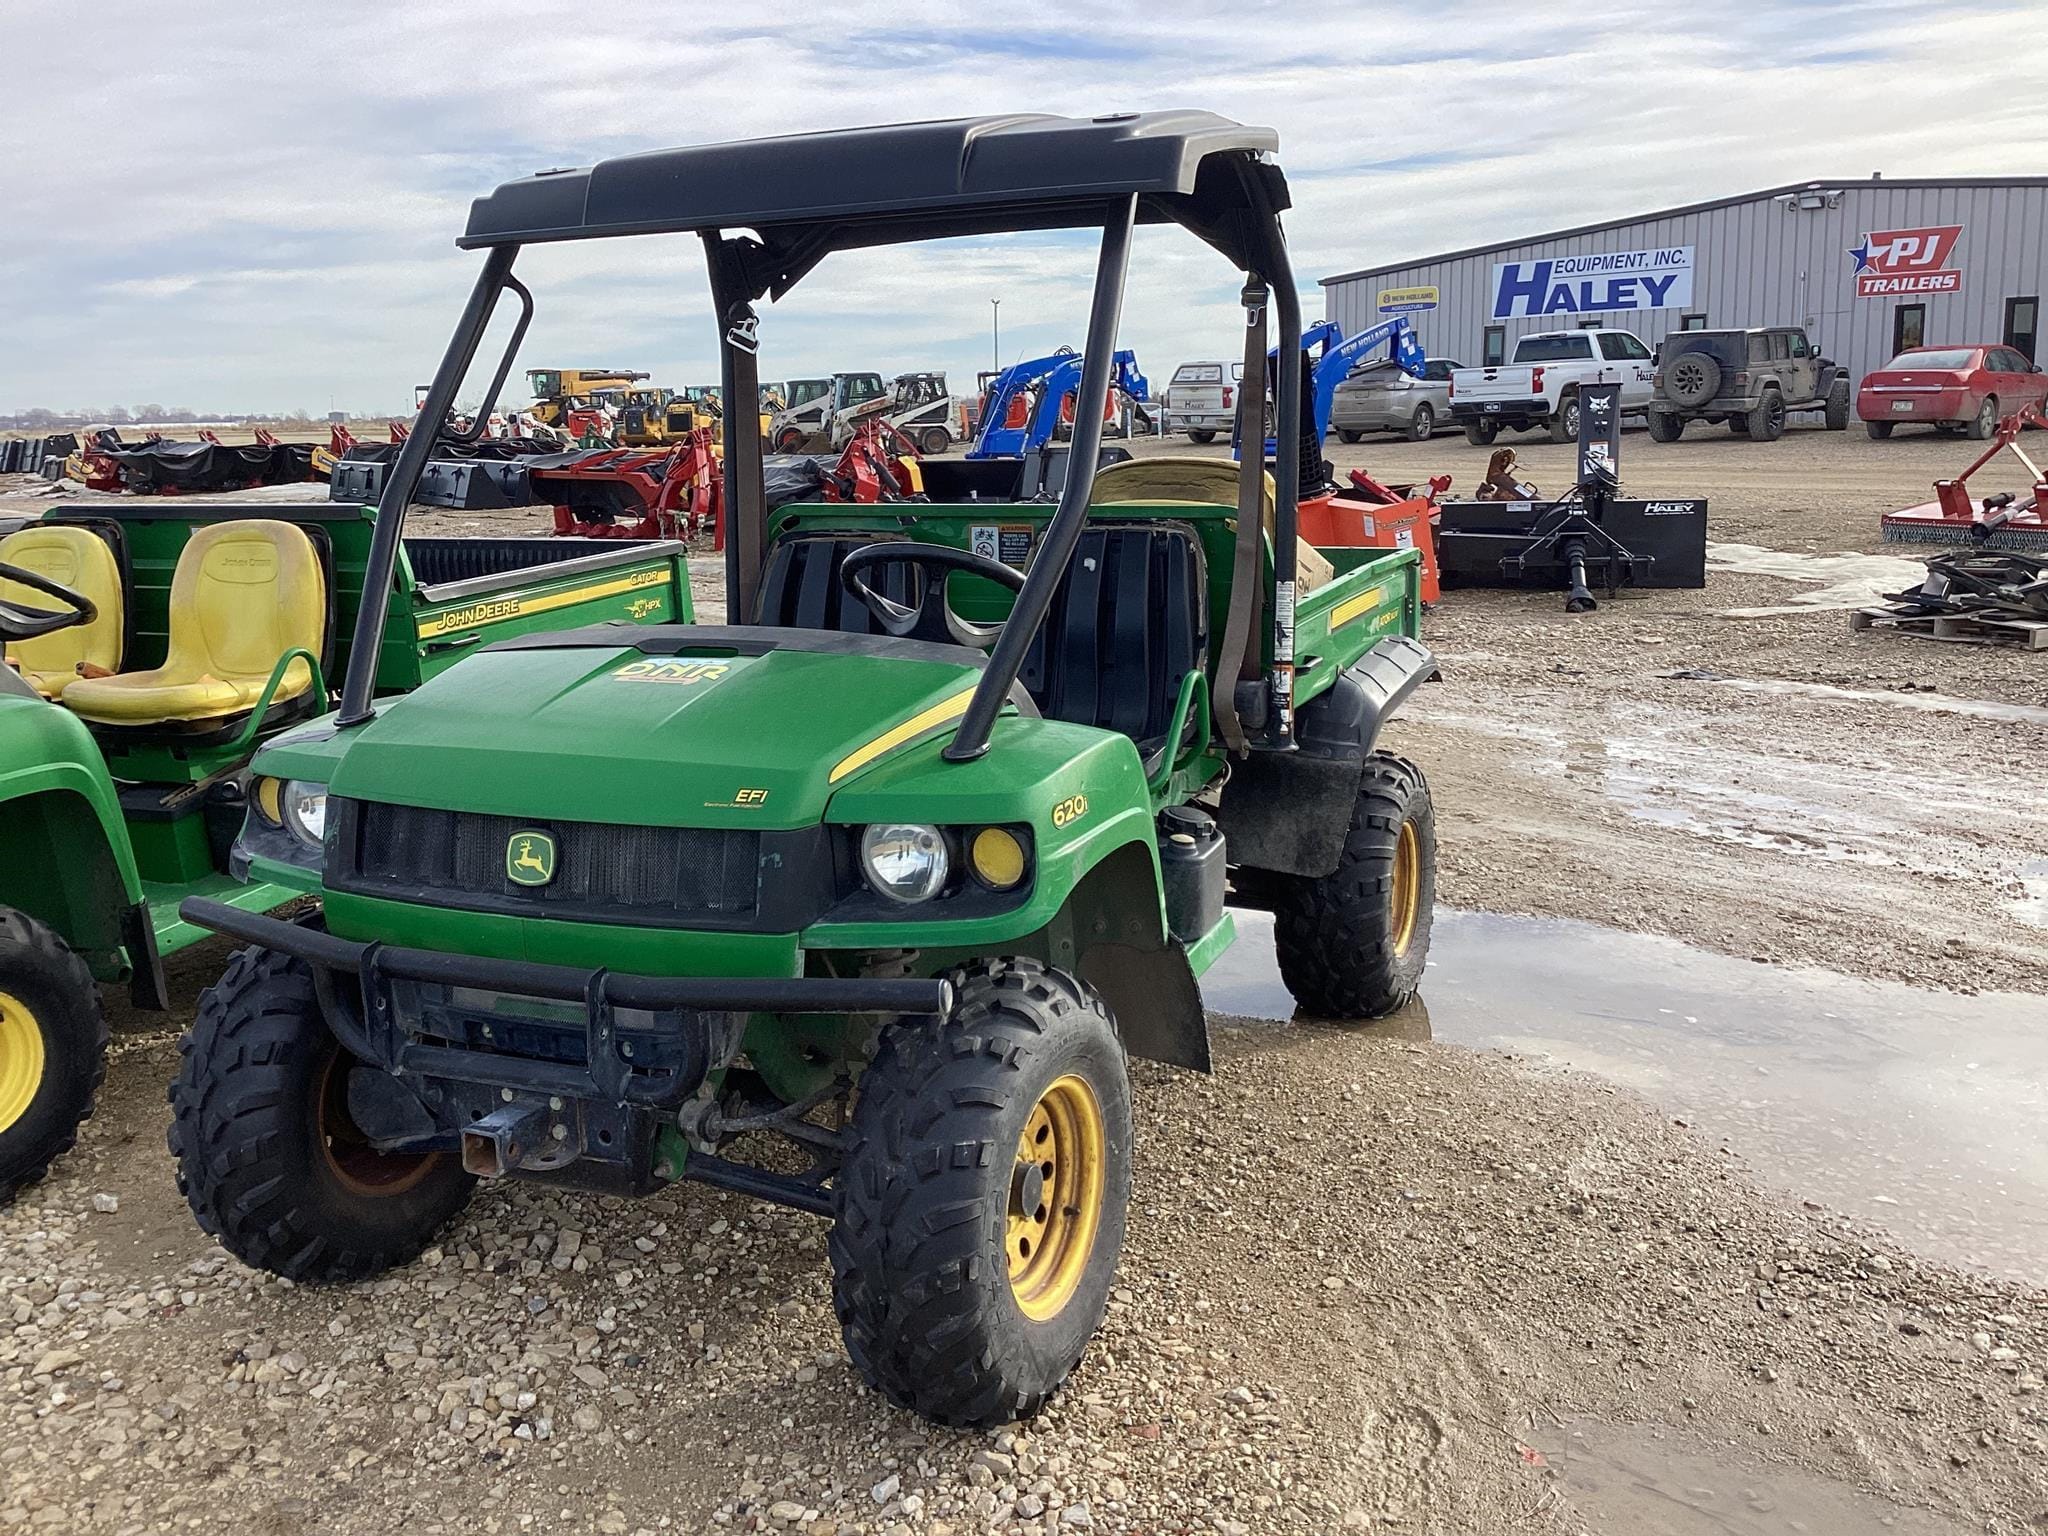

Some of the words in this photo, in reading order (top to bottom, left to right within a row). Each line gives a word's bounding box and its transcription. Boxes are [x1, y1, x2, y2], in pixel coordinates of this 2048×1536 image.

[1885, 235, 1940, 266] PJ
[1554, 253, 1649, 274] EQUIPMENT,
[1654, 249, 1686, 266] INC.
[1494, 262, 1678, 317] HALEY
[1863, 274, 1956, 293] TRAILERS
[1406, 292, 1433, 300] HOLLAND
[1340, 342, 1357, 357] NEW
[1358, 327, 1390, 347] HOLLAND
[1644, 502, 1695, 513] HALEY
[630, 571, 658, 586] GATOR
[645, 599, 661, 610] HPX
[437, 609, 474, 630] JOHN
[475, 600, 520, 621] DEERE
[610, 662, 730, 681] DNR
[735, 789, 769, 803] EFI
[1053, 795, 1088, 826] 620i
